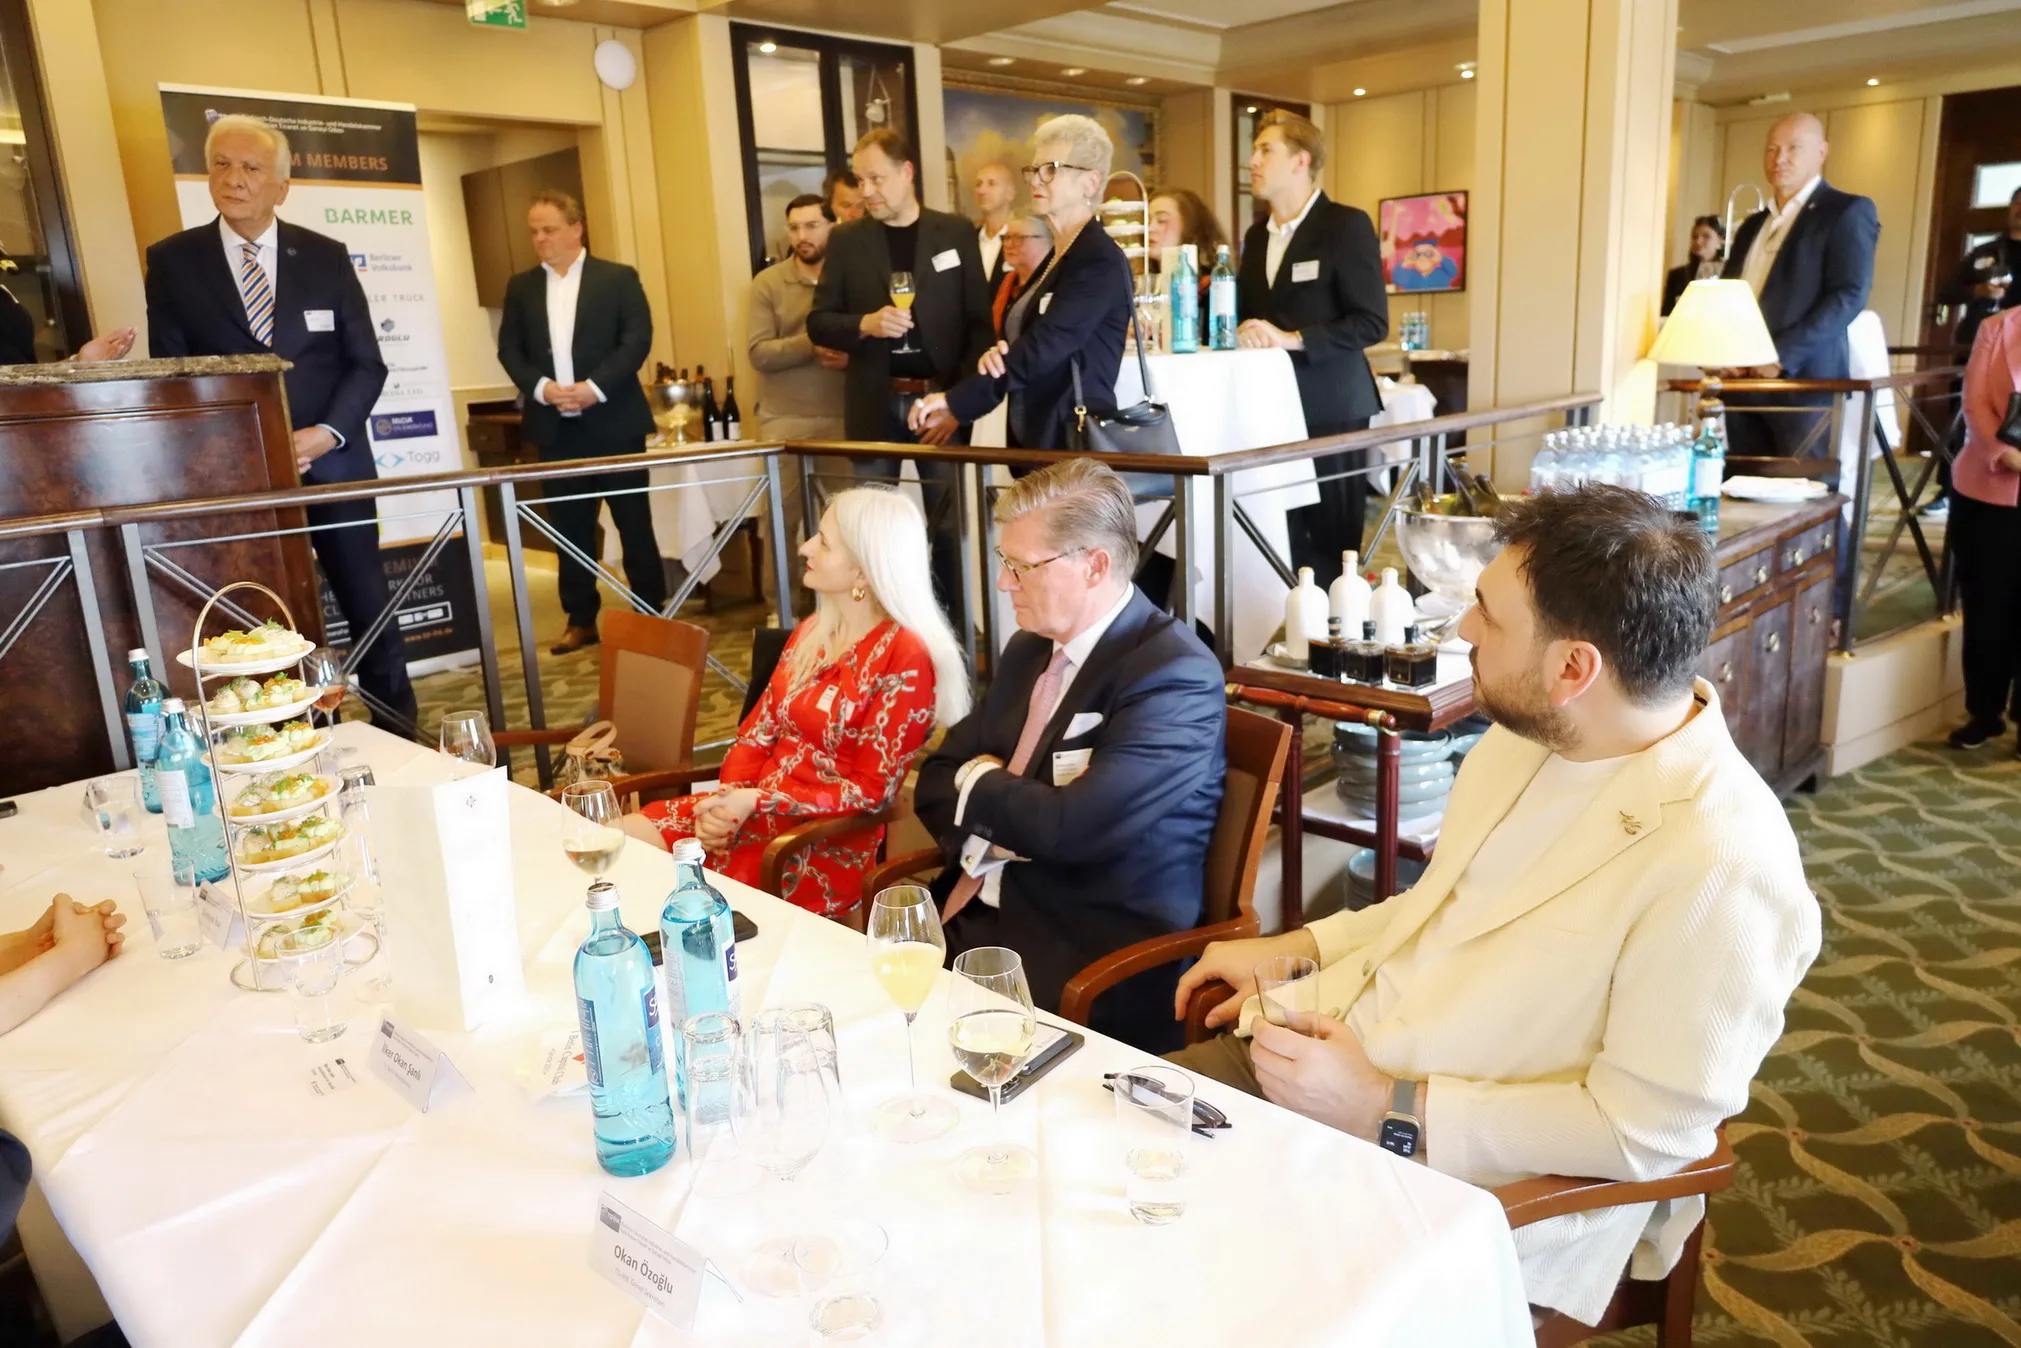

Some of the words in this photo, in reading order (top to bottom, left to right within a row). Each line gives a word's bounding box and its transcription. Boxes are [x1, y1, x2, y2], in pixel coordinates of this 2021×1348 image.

[307, 153, 389, 171] MEMBERS
[324, 208, 414, 225] BARMER
[407, 451, 440, 463] Togg
[393, 1052, 408, 1071] Okan
[613, 1244, 638, 1271] Okan
[640, 1258, 674, 1294] Özoğlu
